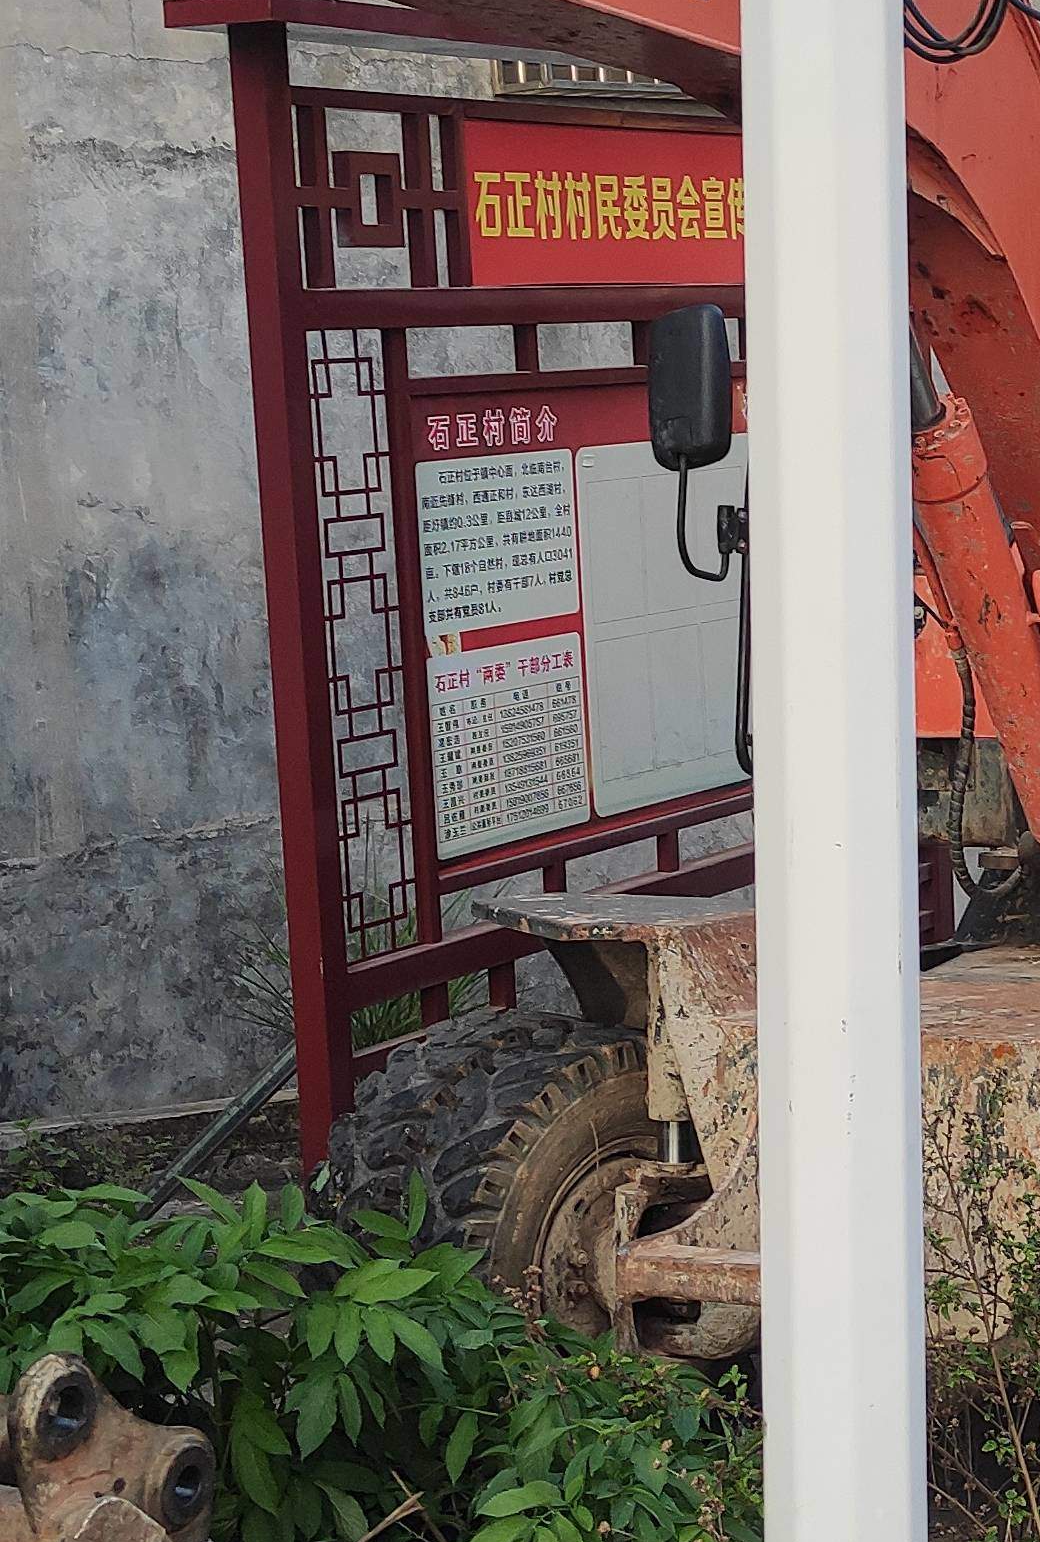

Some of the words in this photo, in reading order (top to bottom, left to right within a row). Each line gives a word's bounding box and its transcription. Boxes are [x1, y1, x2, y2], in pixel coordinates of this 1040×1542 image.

[427, 404, 559, 451] 石正村简介
